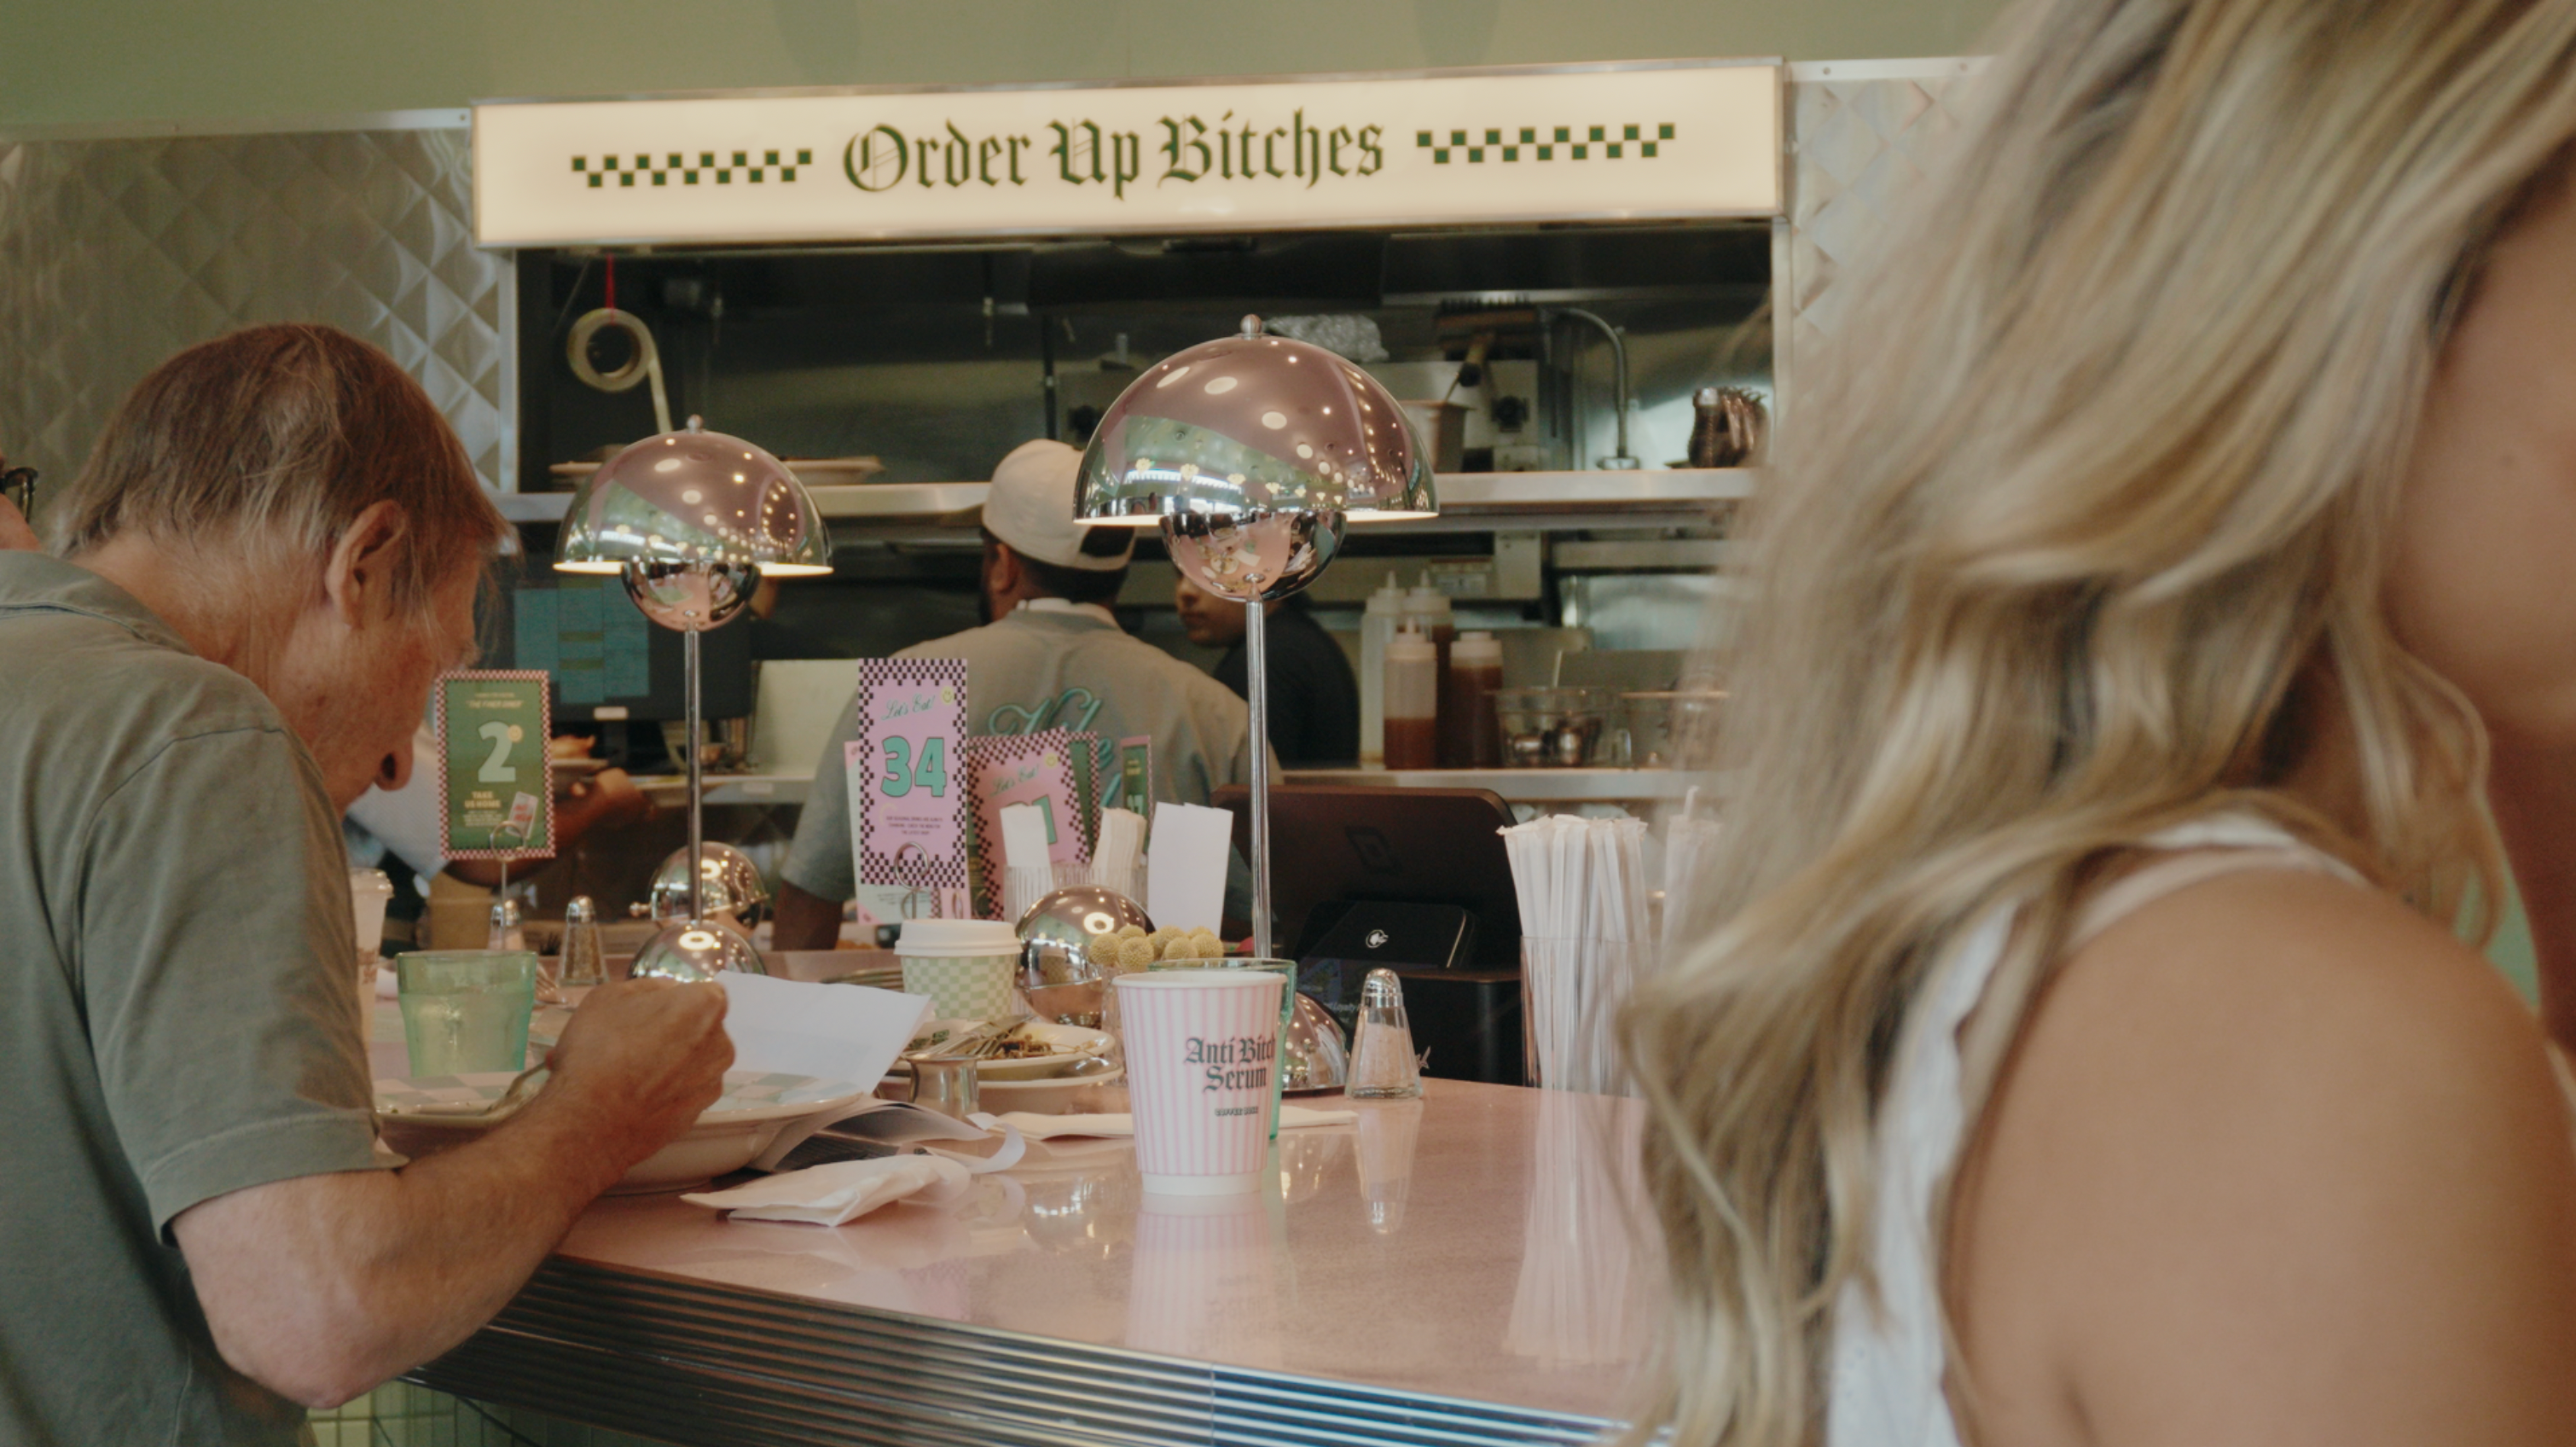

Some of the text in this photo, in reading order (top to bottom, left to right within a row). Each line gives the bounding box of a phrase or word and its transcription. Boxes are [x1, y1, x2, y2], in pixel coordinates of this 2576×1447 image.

[843, 106, 1385, 201] Order Up Bitches
[881, 693, 936, 721] Let's Eat!
[478, 721, 516, 783] 2
[880, 735, 947, 798] 34
[472, 790, 494, 799] TAKE
[476, 799, 501, 809] HOME
[1184, 1037, 1235, 1064] Anti
[1202, 1065, 1267, 1093] Serum
